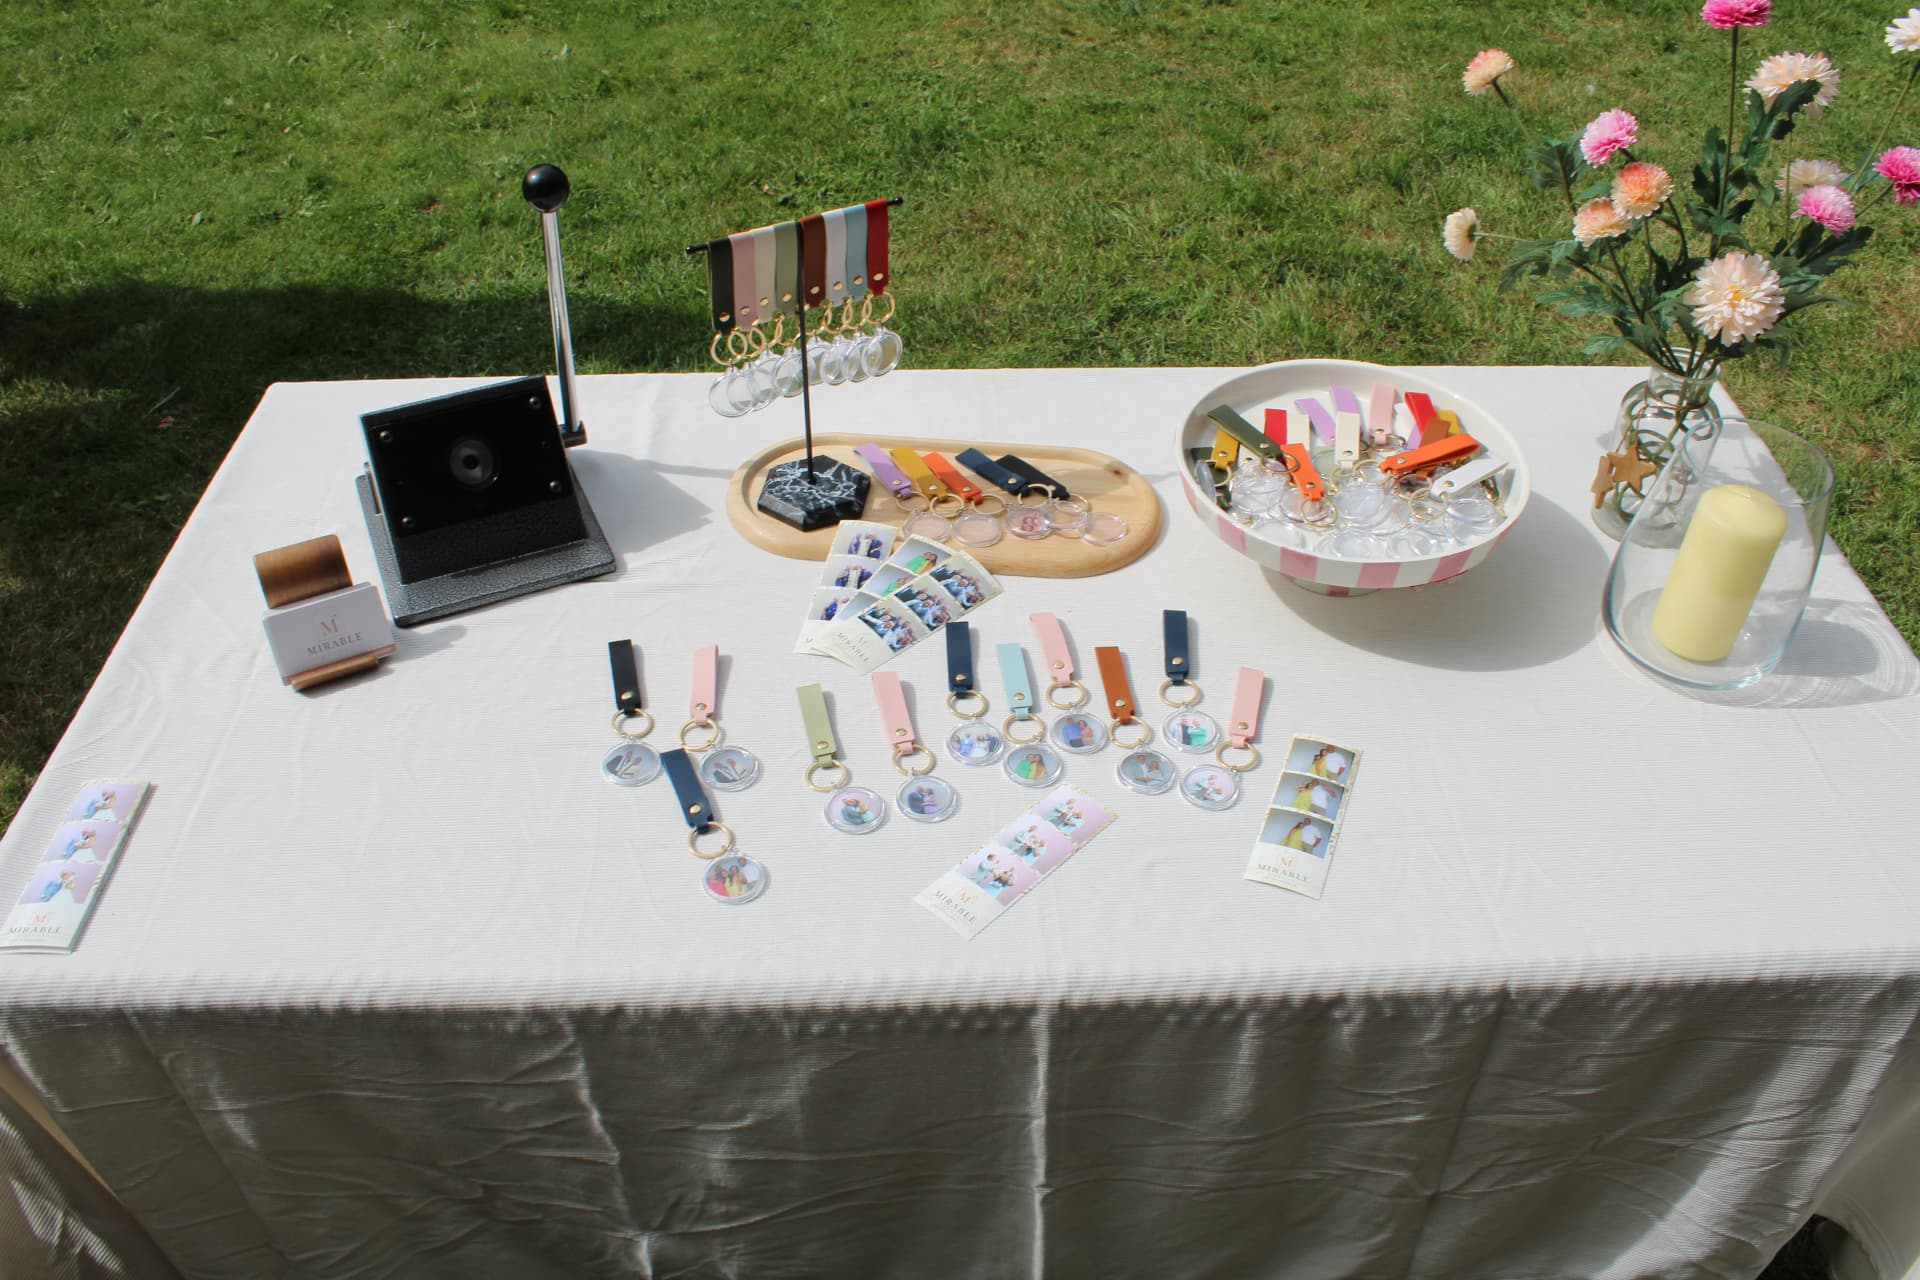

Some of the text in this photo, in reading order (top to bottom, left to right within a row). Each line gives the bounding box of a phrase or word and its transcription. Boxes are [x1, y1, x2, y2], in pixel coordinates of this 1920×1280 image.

[306, 631, 362, 656] MIRABLE
[1256, 863, 1309, 883] MIRABLE
[935, 889, 977, 925] MIRABLE
[8, 926, 62, 935] MIRABLE
